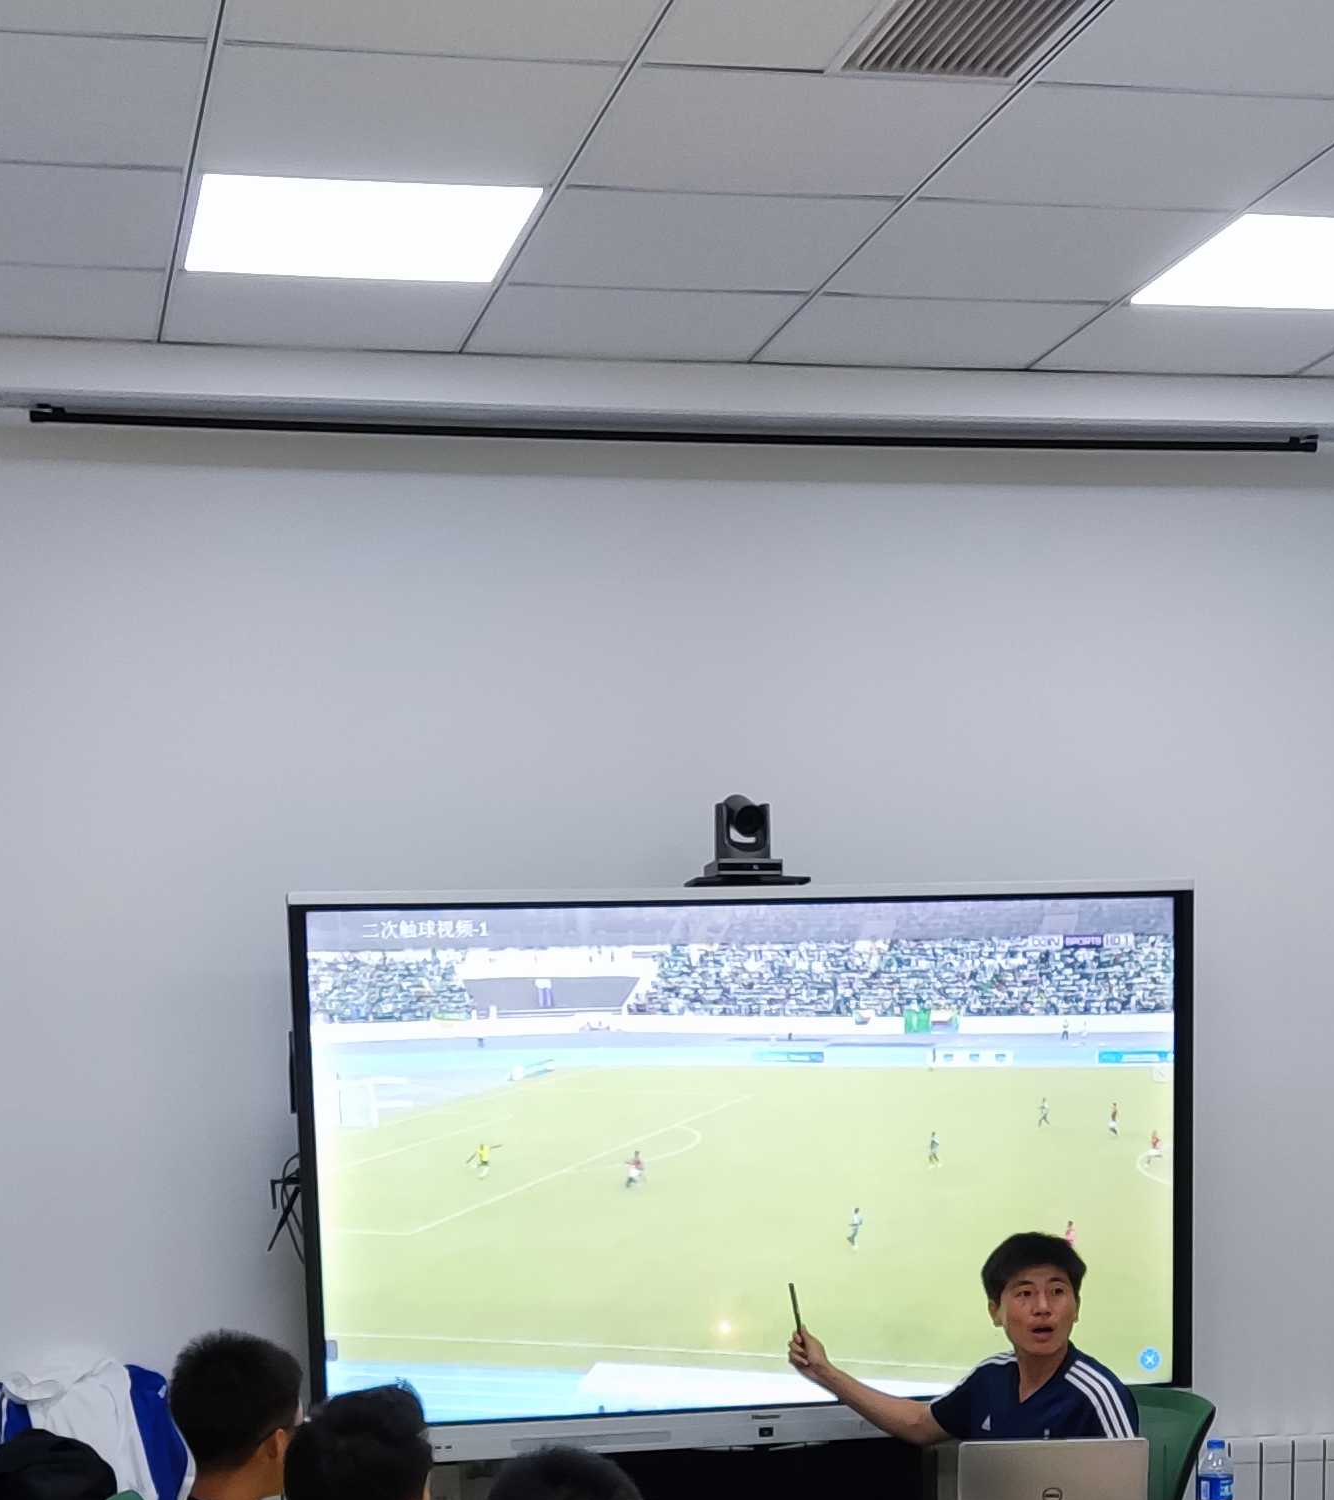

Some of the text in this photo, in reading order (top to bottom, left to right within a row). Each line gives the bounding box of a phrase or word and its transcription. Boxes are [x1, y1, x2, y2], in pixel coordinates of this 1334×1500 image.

[362, 919, 489, 939] 二次触球视频-1
